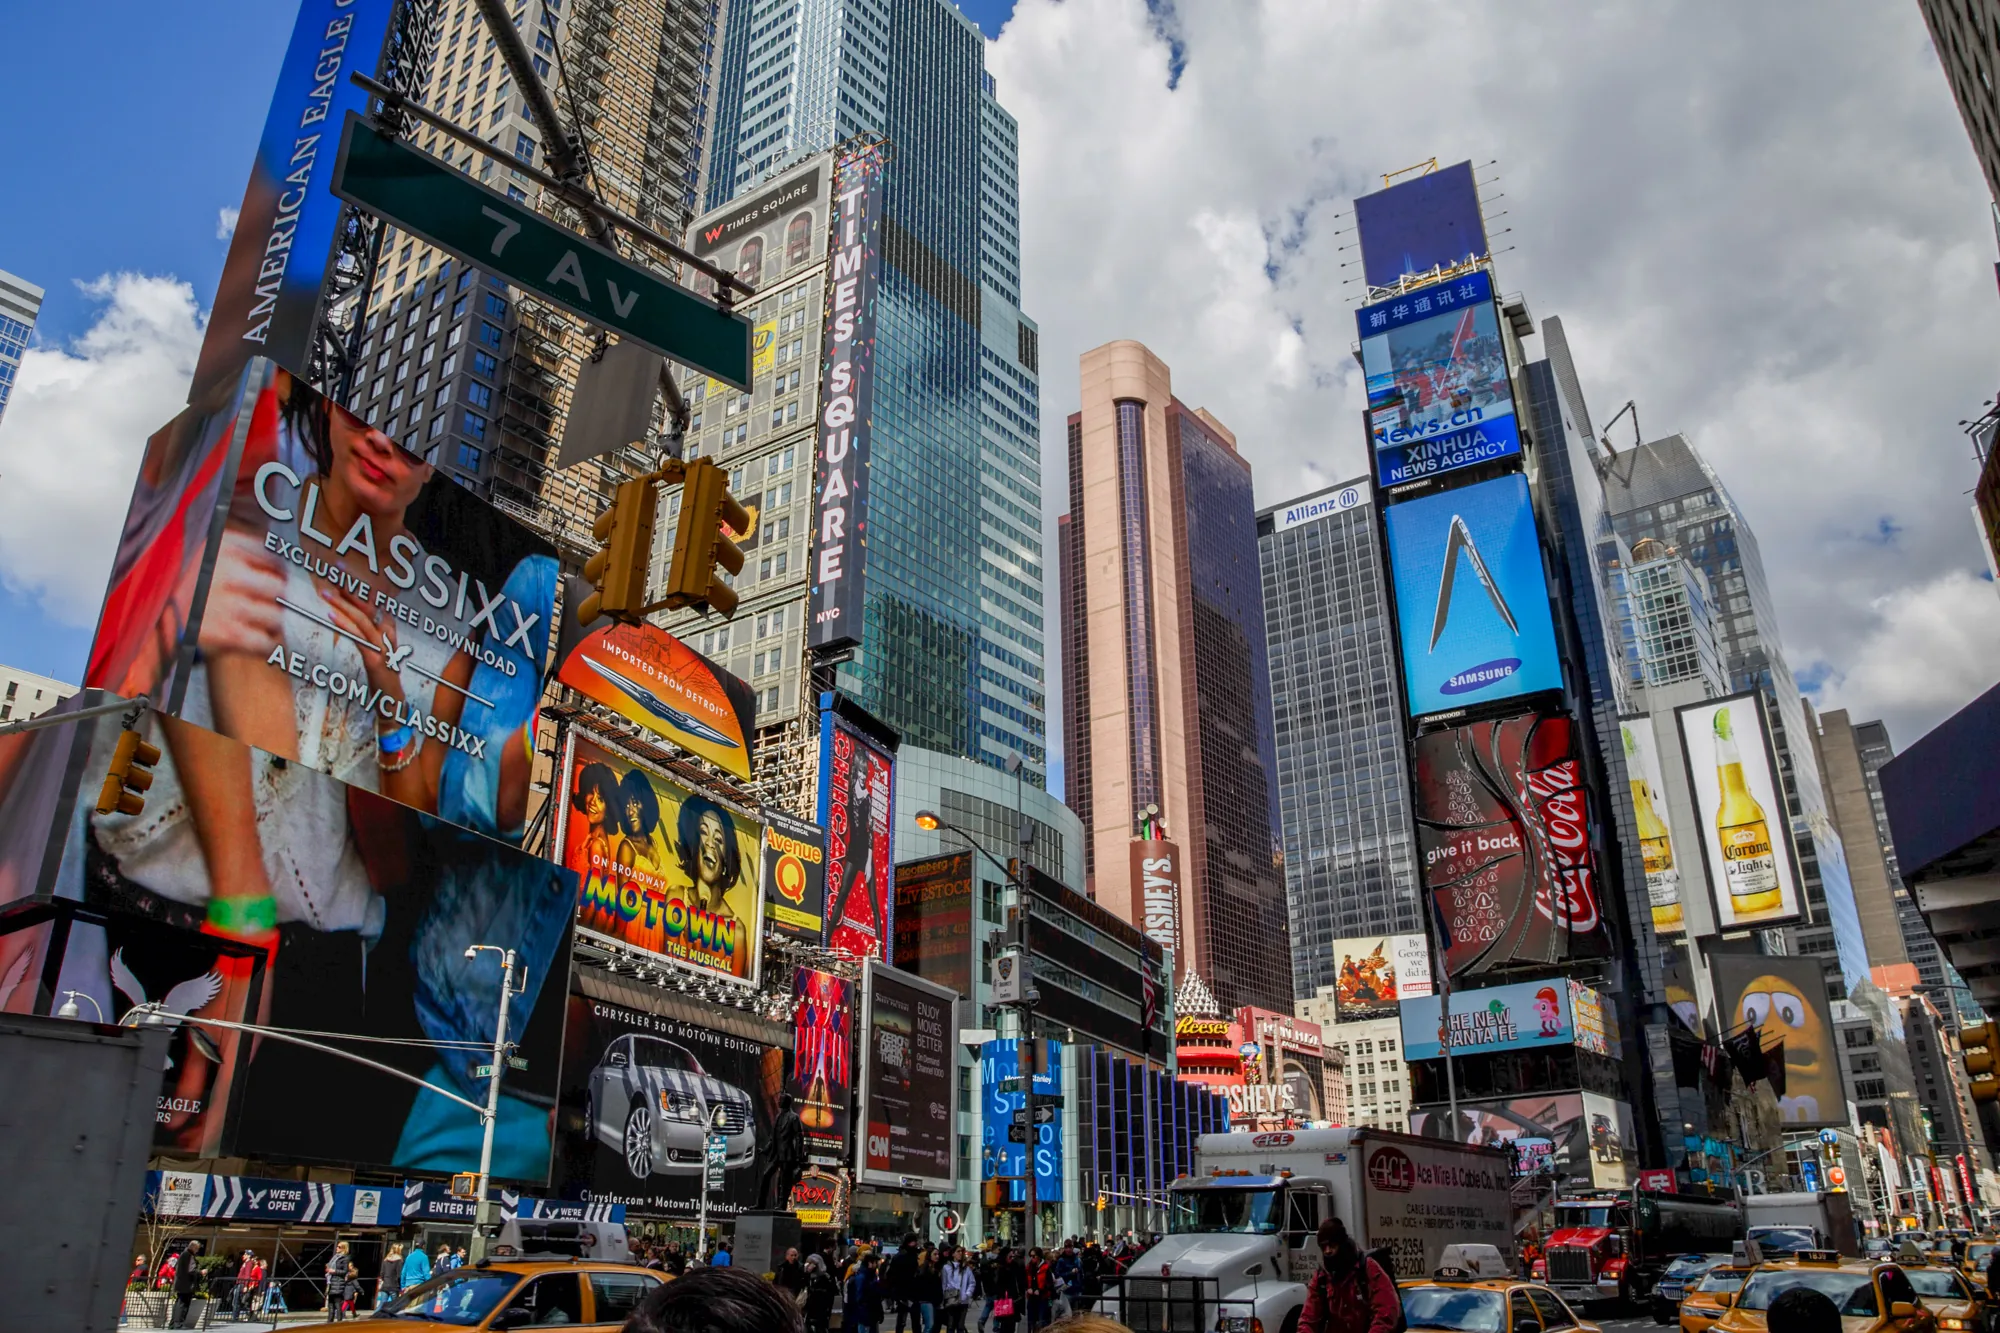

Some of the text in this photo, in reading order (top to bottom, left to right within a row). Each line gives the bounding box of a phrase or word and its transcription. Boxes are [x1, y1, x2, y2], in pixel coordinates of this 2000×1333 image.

[242, 13, 354, 345] AMERICAN EAGLE
[705, 184, 808, 245] W TIMES SQUARE
[481, 205, 521, 258] 7
[1370, 283, 1477, 328] 新华通讯社
[819, 185, 865, 584] TIMES SQUARE
[1406, 429, 1488, 464] XINHUA
[1391, 439, 1508, 481] NEWS AGENCY
[1285, 499, 1336, 525] Allianz
[254, 461, 540, 660] CLASSIXX
[264, 531, 517, 678] EXCLUSIVE FREE DOWNLOAD
[816, 607, 840, 624] NYC
[602, 639, 656, 677] IMPORTED
[657, 672, 683, 694] FROM
[1449, 664, 1513, 687] SAMSUNG
[267, 645, 487, 760] AE.COM/CLASSIXX
[767, 825, 822, 864] Avenue
[1427, 832, 1520, 863] give it back
[1724, 842, 1770, 861] Corona
[592, 853, 666, 892] ON BROADWAY
[897, 860, 948, 878] Bloomberg
[1736, 859, 1763, 875] Light
[775, 853, 806, 906] Q
[896, 878, 972, 907] LIVESTOCK
[580, 867, 737, 955] MOTOWN
[1409, 939, 1420, 950] By
[667, 940, 733, 974] THE MUSICAL
[1405, 967, 1430, 977] did it.
[800, 995, 848, 1014] JOIN US
[917, 1001, 940, 1020] ENJOY
[917, 1017, 942, 1037] MOVIES
[1176, 1015, 1230, 1035] Reese's
[1474, 1008, 1510, 1027] NEW
[594, 1005, 761, 1055] CHRYSLER 300 MOTOWN EDITION
[880, 1030, 904, 1047] ZERO
[1498, 1024, 1518, 1042] FE
[917, 1033, 943, 1053] BETTER
[792, 1026, 848, 1089] PIPPIN
[916, 1063, 944, 1078] Channel 1000
[868, 1134, 889, 1158] CNN
[1254, 1134, 1288, 1146] ACE
[1370, 1154, 1409, 1187] ACE
[1417, 1163, 1433, 1183] Ace
[1433, 1164, 1451, 1186] Wire
[1452, 1168, 1459, 1186] &
[1460, 1167, 1480, 1190] Cable
[270, 1189, 301, 1200] WE'RE
[580, 1189, 644, 1206] Chrysler.com
[792, 1181, 835, 1205] ROXY
[268, 1200, 295, 1211] OPEN
[429, 1201, 463, 1216] ENTER
[561, 1208, 582, 1217] WE'RE
[1406, 1203, 1425, 1215] CABLE
[1380, 1216, 1394, 1227] DATA
